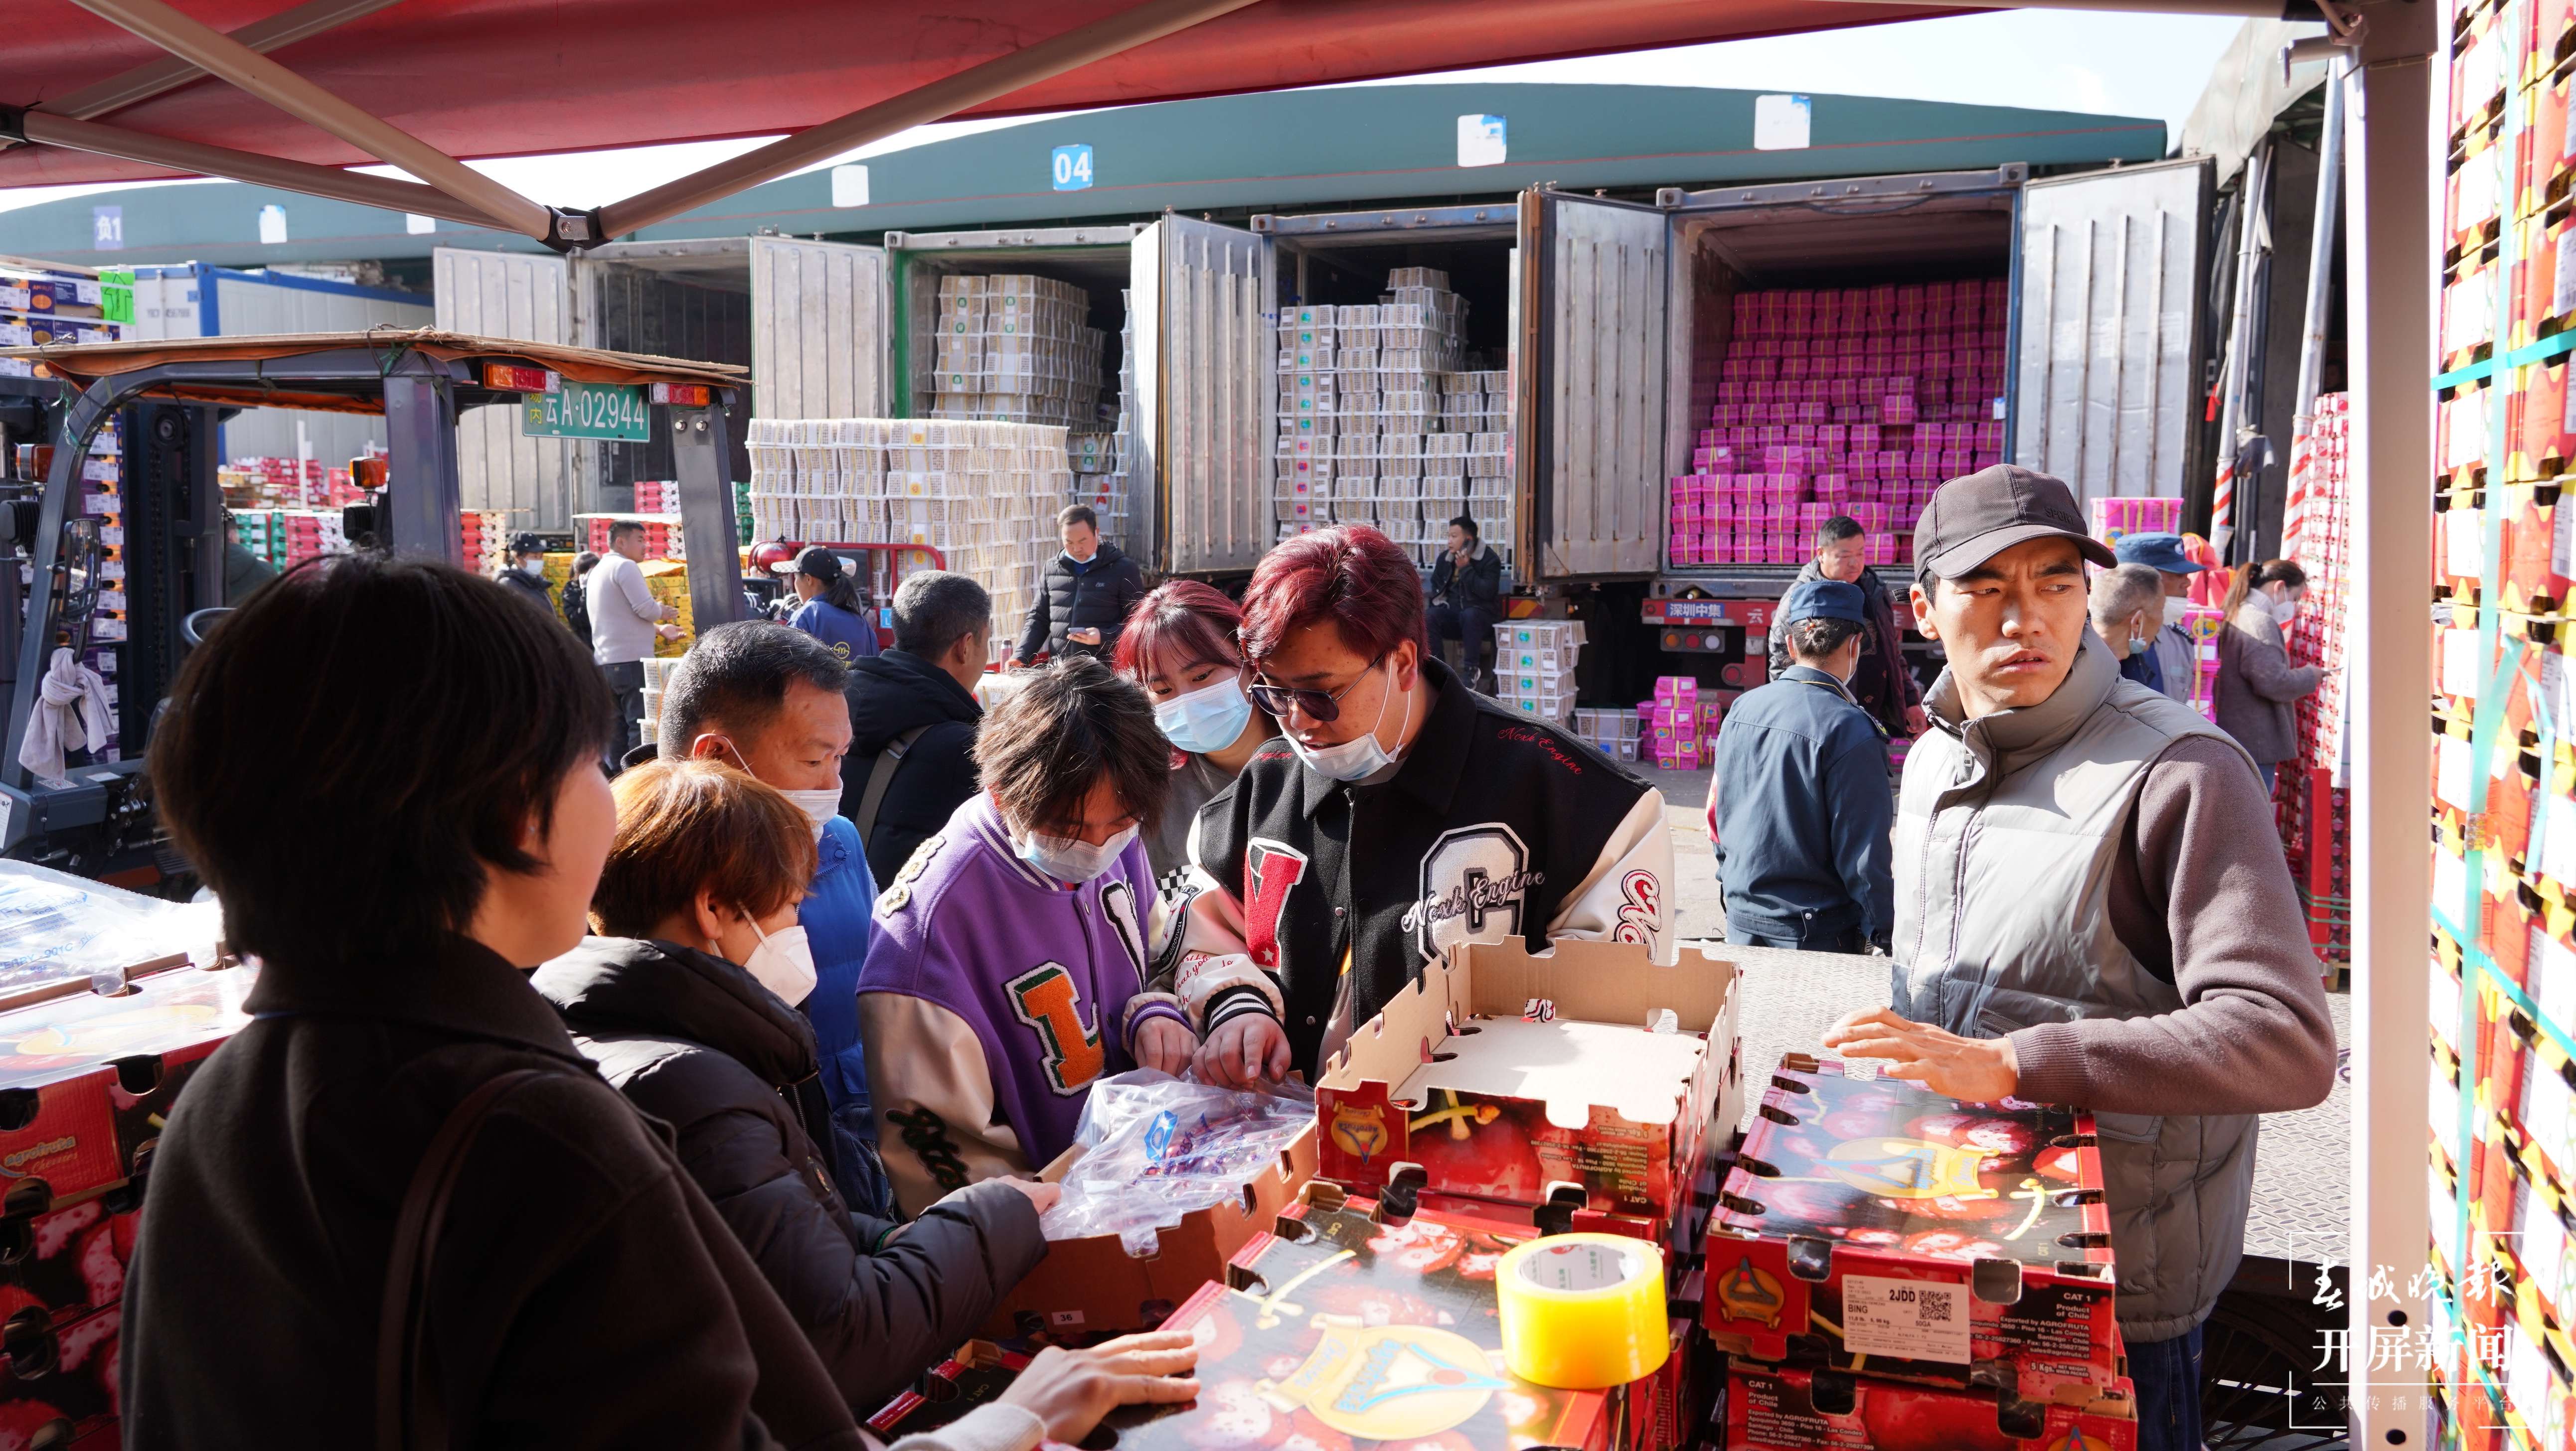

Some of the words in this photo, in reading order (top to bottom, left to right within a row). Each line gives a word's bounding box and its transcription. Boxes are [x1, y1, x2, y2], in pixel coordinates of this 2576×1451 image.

[1055, 151, 1092, 184] 04
[1670, 603, 1721, 617] 深圳中集
[1468, 870, 1545, 910] Engine
[4, 1136, 76, 1167] agrofruta
[1572, 1164, 1613, 1172] AGROFRUTA
[1618, 1184, 1647, 1193] Product
[1327, 1222, 1342, 1235] CAT
[1890, 1290, 1915, 1302] 2JDD
[2064, 1293, 2083, 1301] CAT
[1848, 1305, 1868, 1313] BING
[2056, 1304, 2090, 1313] Product
[2000, 1316, 2029, 1324] Exported
[2040, 1321, 2090, 1331] AGROFRUTA
[2038, 1333, 2067, 1342] Santiago
[2031, 1362, 2036, 1371] 5
[2039, 1363, 2055, 1373] Kgs.
[1749, 1380, 1766, 1389] CAT
[1749, 1392, 1778, 1401] Product
[1748, 1409, 1774, 1418] Exported
[1784, 1414, 1828, 1425] AGROFRUTA
[1748, 1416, 1779, 1425] Apoquindo
[1748, 1423, 1773, 1431] Santiago
